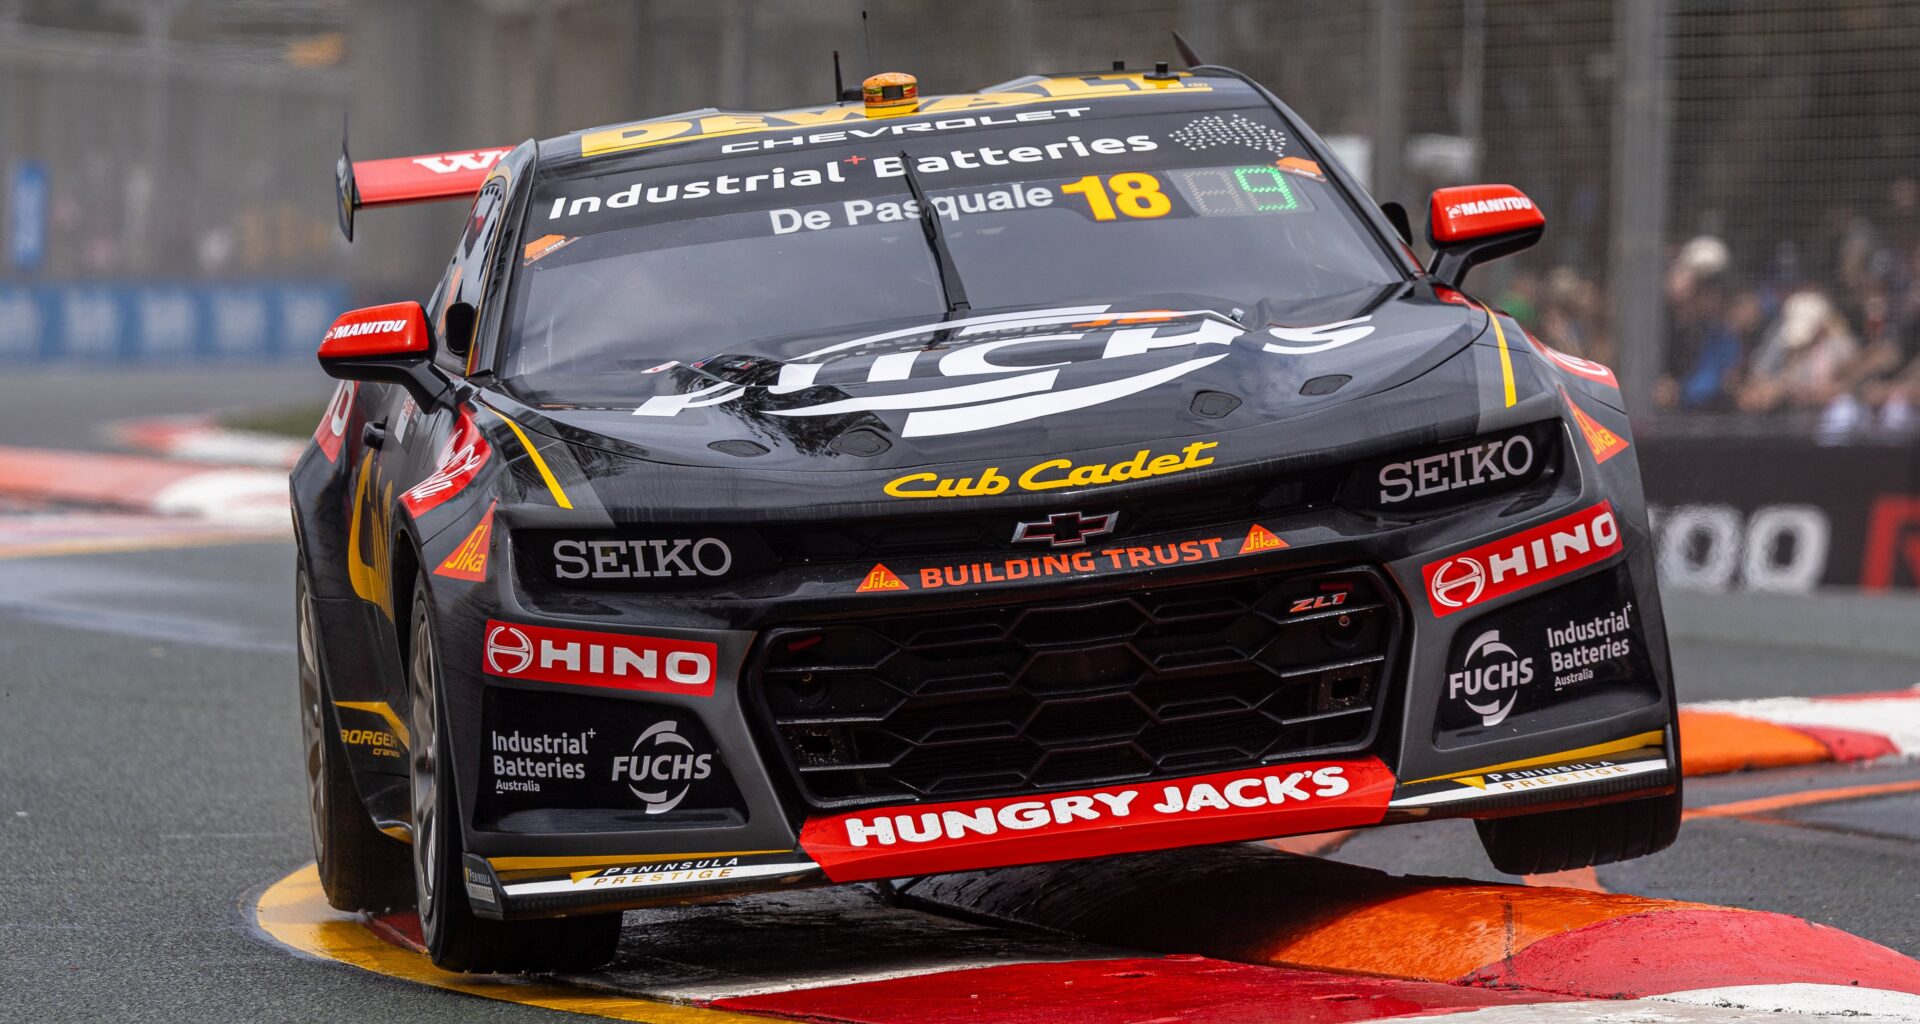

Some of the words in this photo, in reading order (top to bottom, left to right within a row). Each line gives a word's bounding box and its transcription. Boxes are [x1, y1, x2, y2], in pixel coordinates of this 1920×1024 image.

[721, 107, 1091, 154] CHEVROLET
[872, 132, 1159, 178] Batteries
[769, 207, 831, 235] De
[843, 183, 1054, 226] Pasquale
[1060, 172, 1172, 221] 18
[1459, 196, 1533, 216] MANITOU
[333, 320, 407, 340] MANITOU
[883, 467, 1010, 498] Cub
[1018, 441, 1219, 491] Cadet
[1379, 435, 1533, 504] SEIKO
[444, 524, 486, 573] Sika
[553, 537, 732, 579] SEIKO
[1244, 532, 1281, 552] Sika
[1489, 511, 1618, 584] HINO
[1647, 503, 1832, 592] 00
[862, 572, 900, 591] Sika
[920, 551, 1096, 589] BUILDING
[1101, 538, 1222, 569] TRUST
[1289, 592, 1347, 613] ZL1
[540, 639, 711, 684] HINO
[1551, 638, 1630, 672] Batteries
[1450, 657, 1533, 699] FUCHS
[1554, 669, 1594, 690] Australia
[493, 755, 585, 779] Batteries
[496, 779, 541, 793] Australia
[611, 753, 712, 781] FUCHS
[1486, 760, 1615, 782] PENINSULA
[1504, 765, 1630, 790] PRESTIGE
[846, 790, 1138, 847] HUNGRY
[1152, 766, 1350, 812] JACK'S
[593, 868, 735, 886] PRESTIGE
[602, 857, 740, 876] PENINSULA
